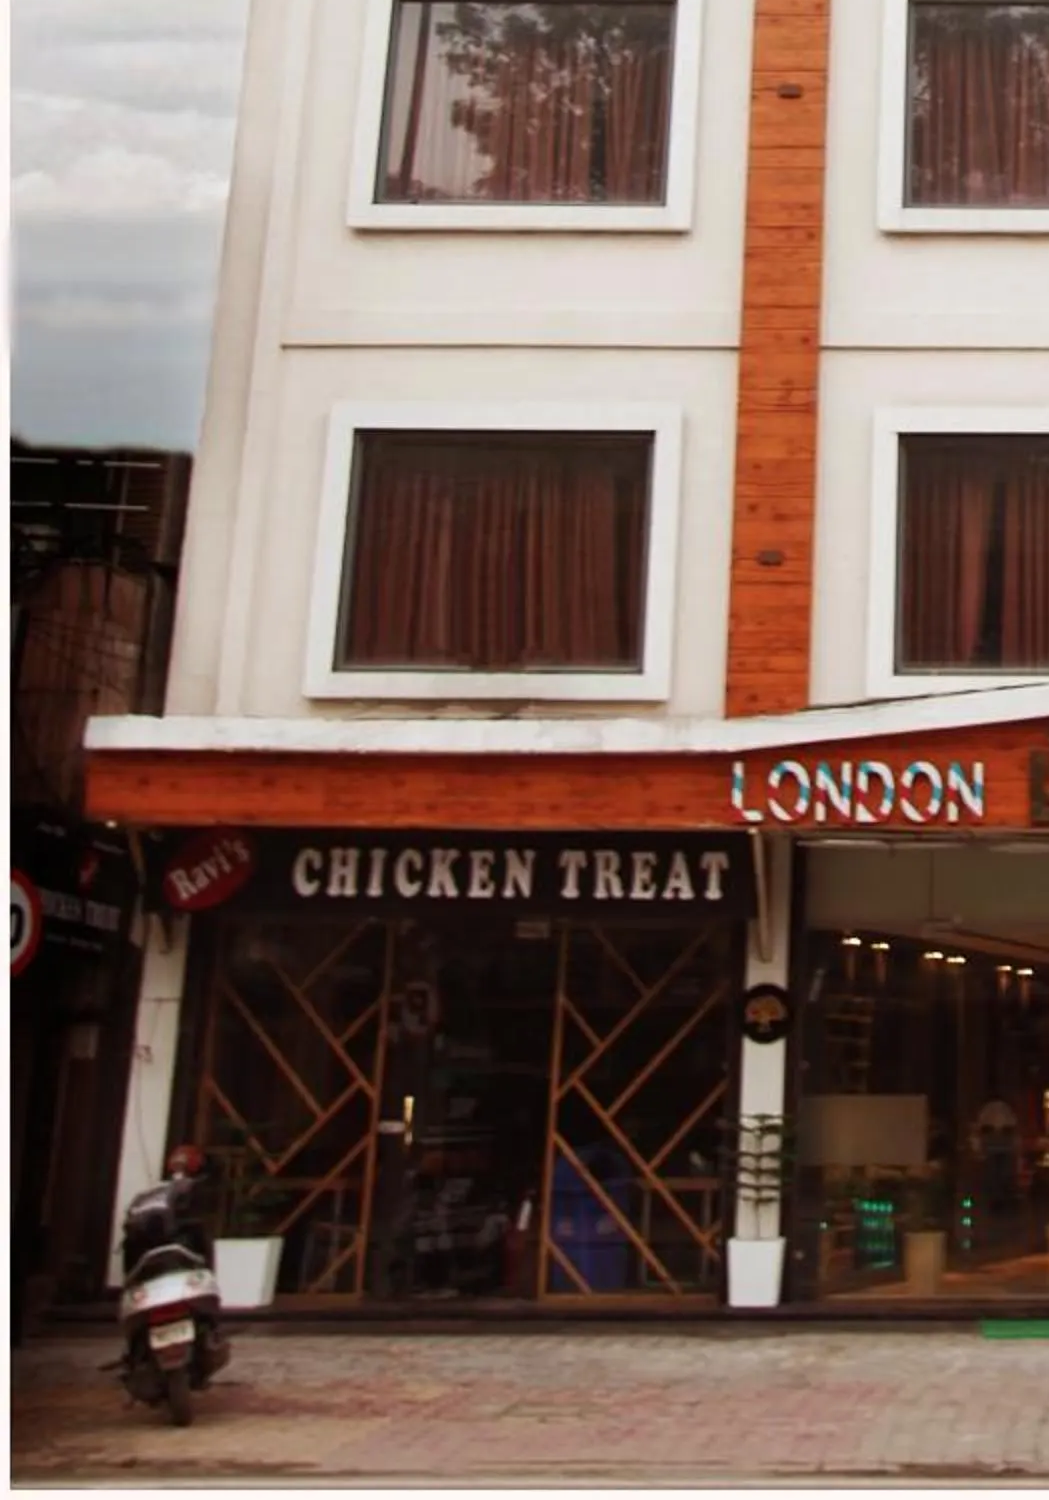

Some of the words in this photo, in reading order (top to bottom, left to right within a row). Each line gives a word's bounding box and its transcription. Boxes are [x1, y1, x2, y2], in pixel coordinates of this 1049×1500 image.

[731, 760, 985, 823] LONDON
[169, 838, 250, 901] Ravi's
[292, 847, 536, 898] CHICKEN
[559, 849, 730, 900] TREAT
